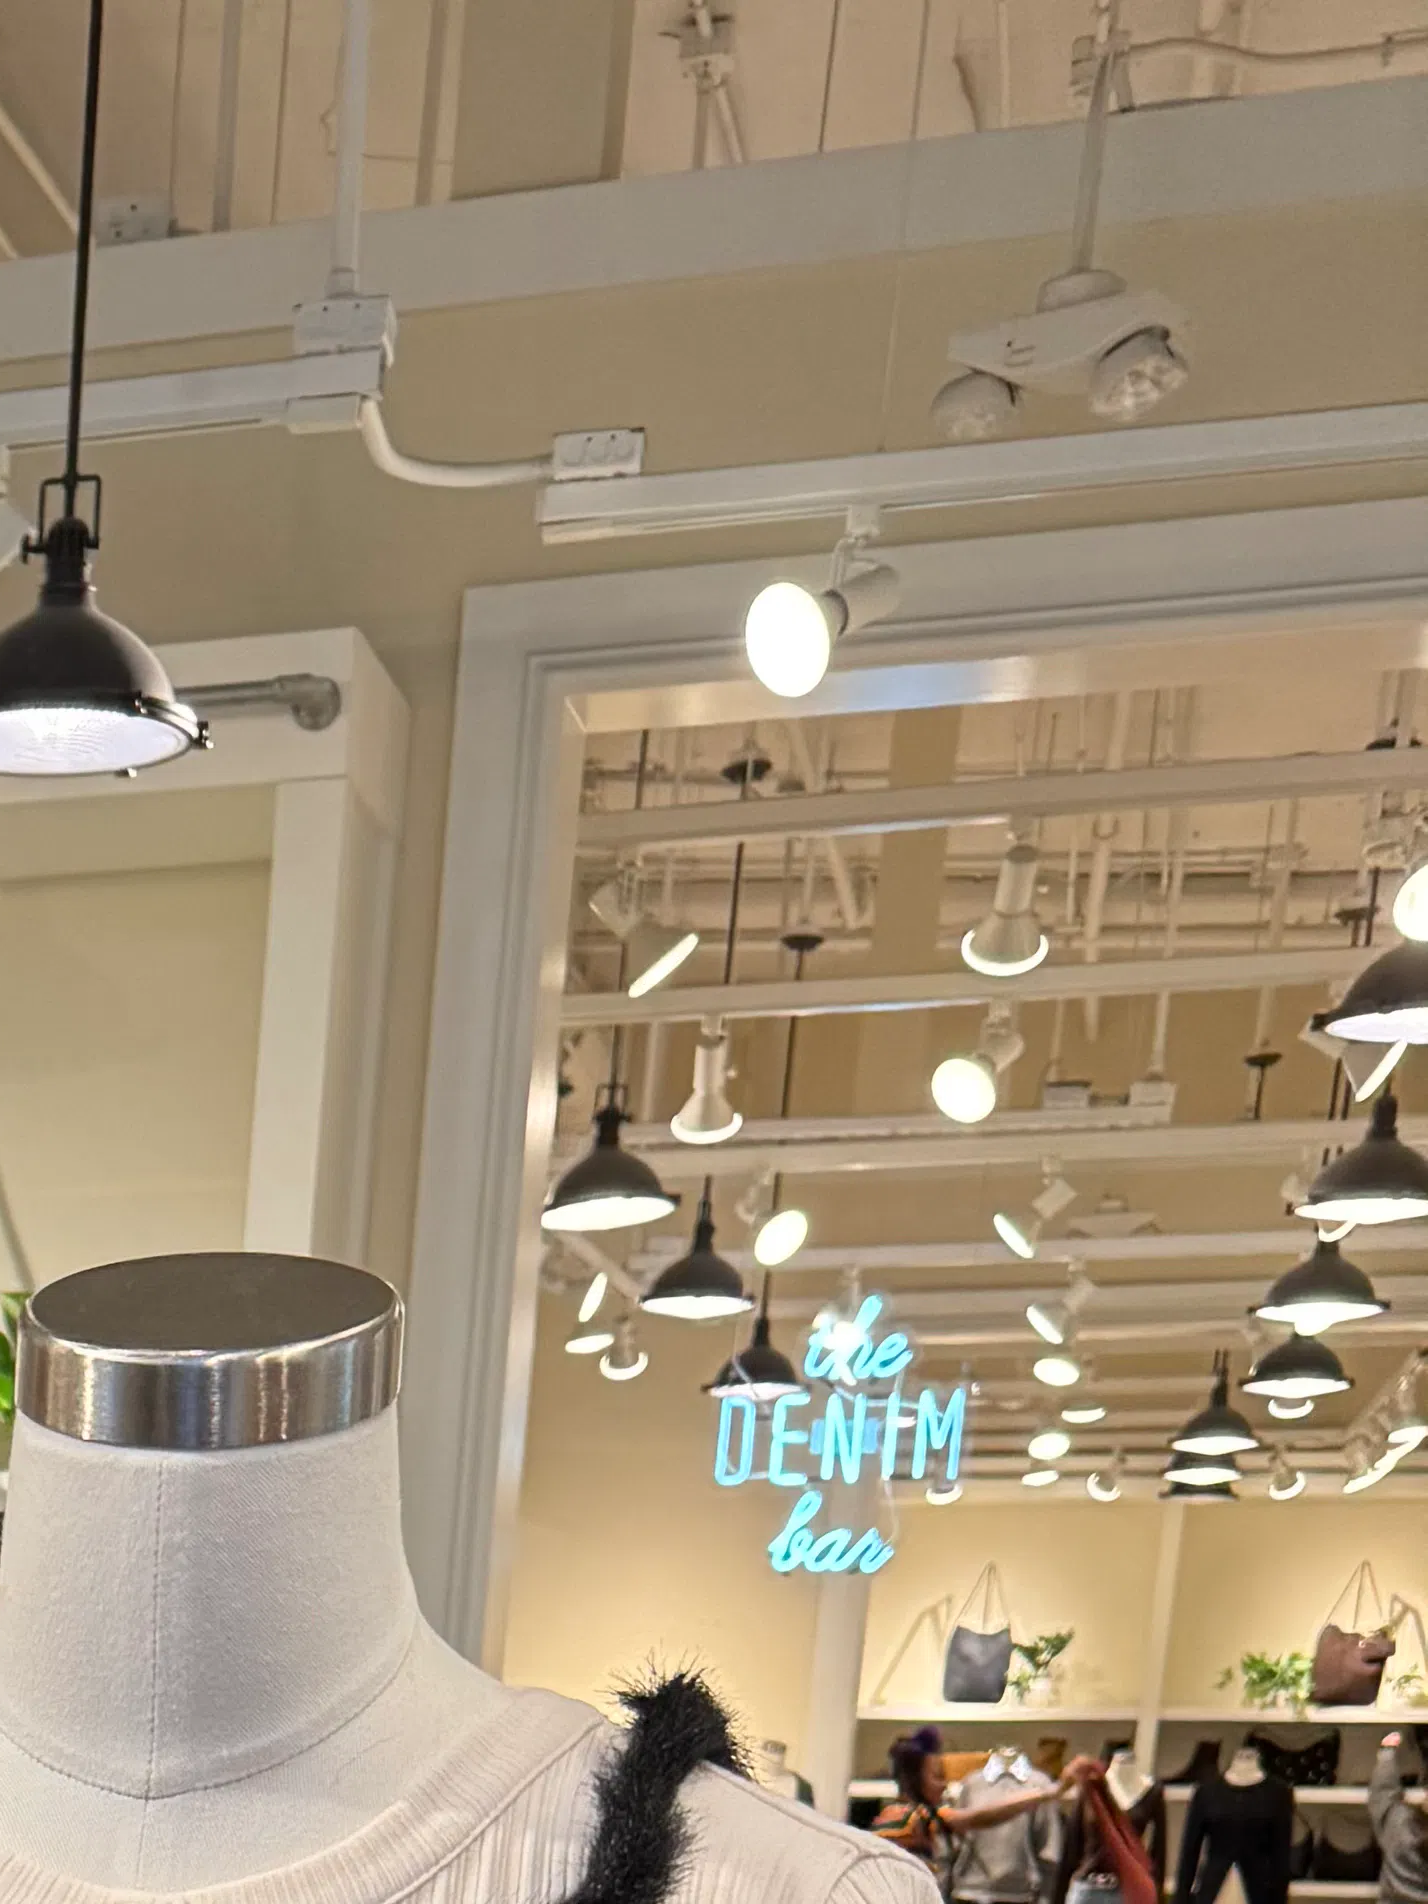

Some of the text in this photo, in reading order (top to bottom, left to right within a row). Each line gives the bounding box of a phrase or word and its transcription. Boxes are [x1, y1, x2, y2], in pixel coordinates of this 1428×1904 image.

[803, 1294, 913, 1382] the
[713, 1388, 966, 1486] DENIM
[767, 1490, 895, 1574] bar
